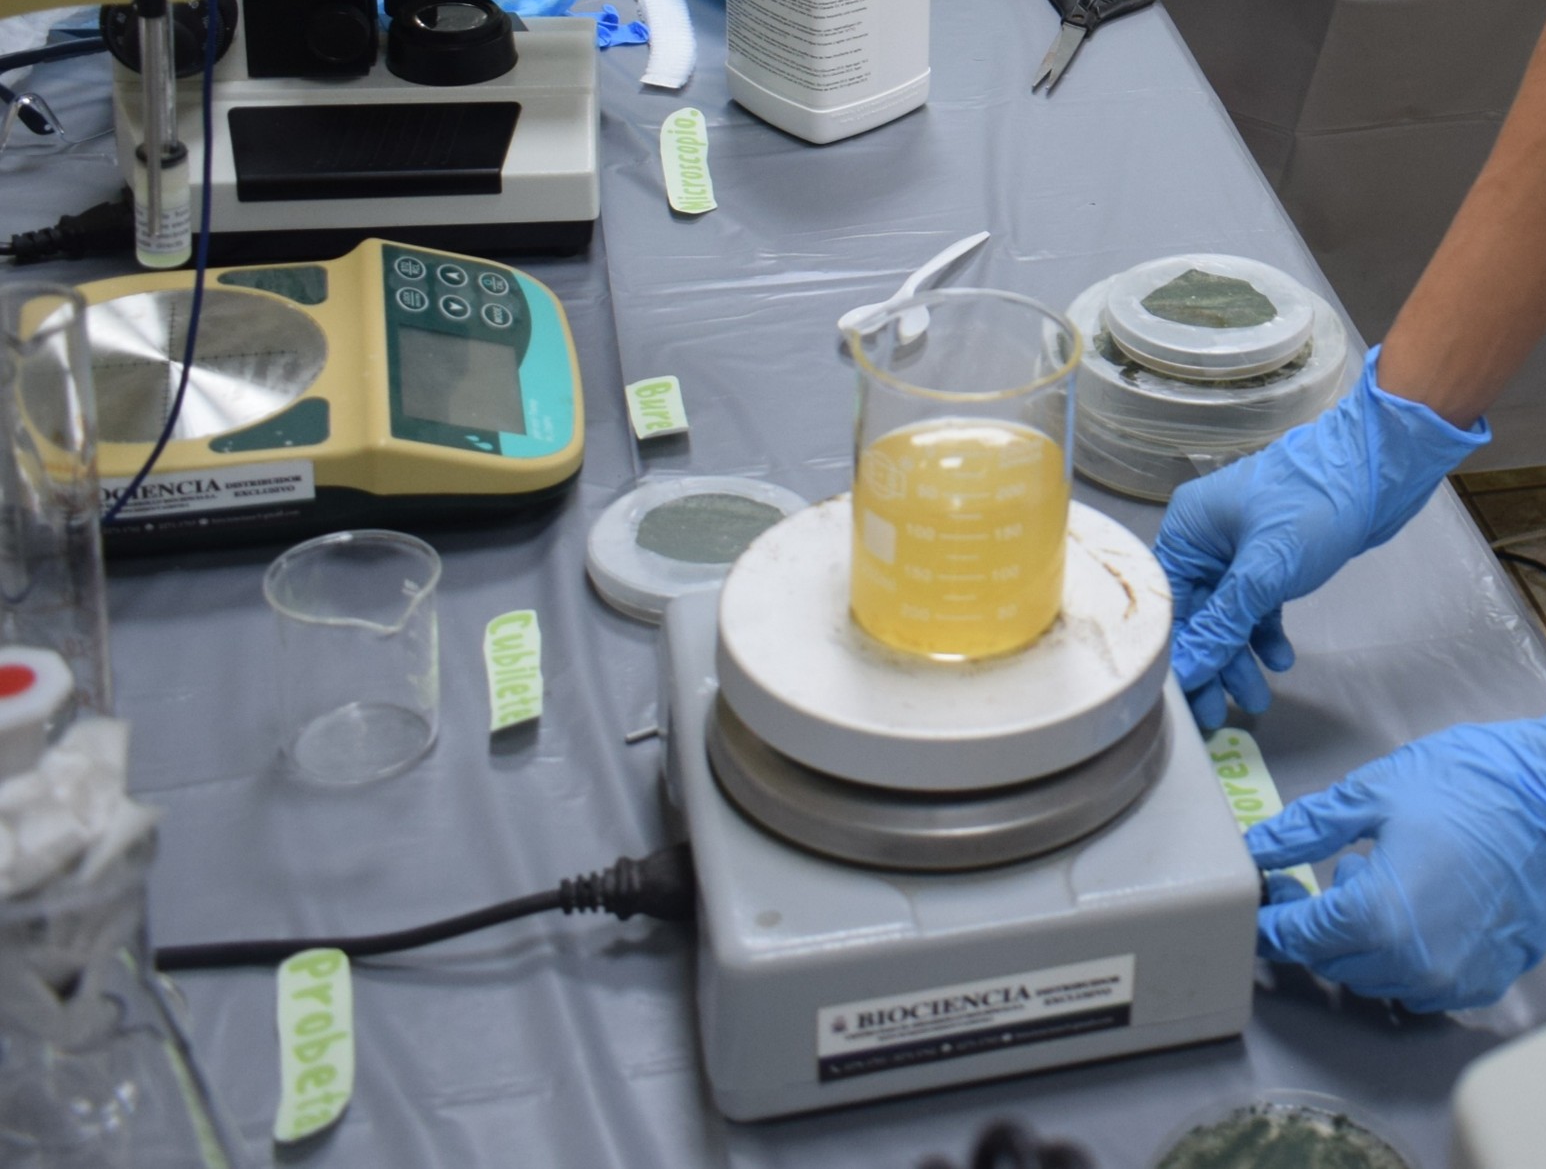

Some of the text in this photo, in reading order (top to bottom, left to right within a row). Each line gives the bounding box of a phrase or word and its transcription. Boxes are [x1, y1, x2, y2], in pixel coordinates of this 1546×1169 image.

[667, 110, 713, 210] Microscopio.
[225, 474, 303, 491] DISTRIBUIDOR
[233, 485, 296, 499] EXCLUSIVO
[488, 613, 540, 724] Cubilete
[857, 983, 1031, 1029] BIOCIENCIA
[288, 953, 348, 1139] Probeta
